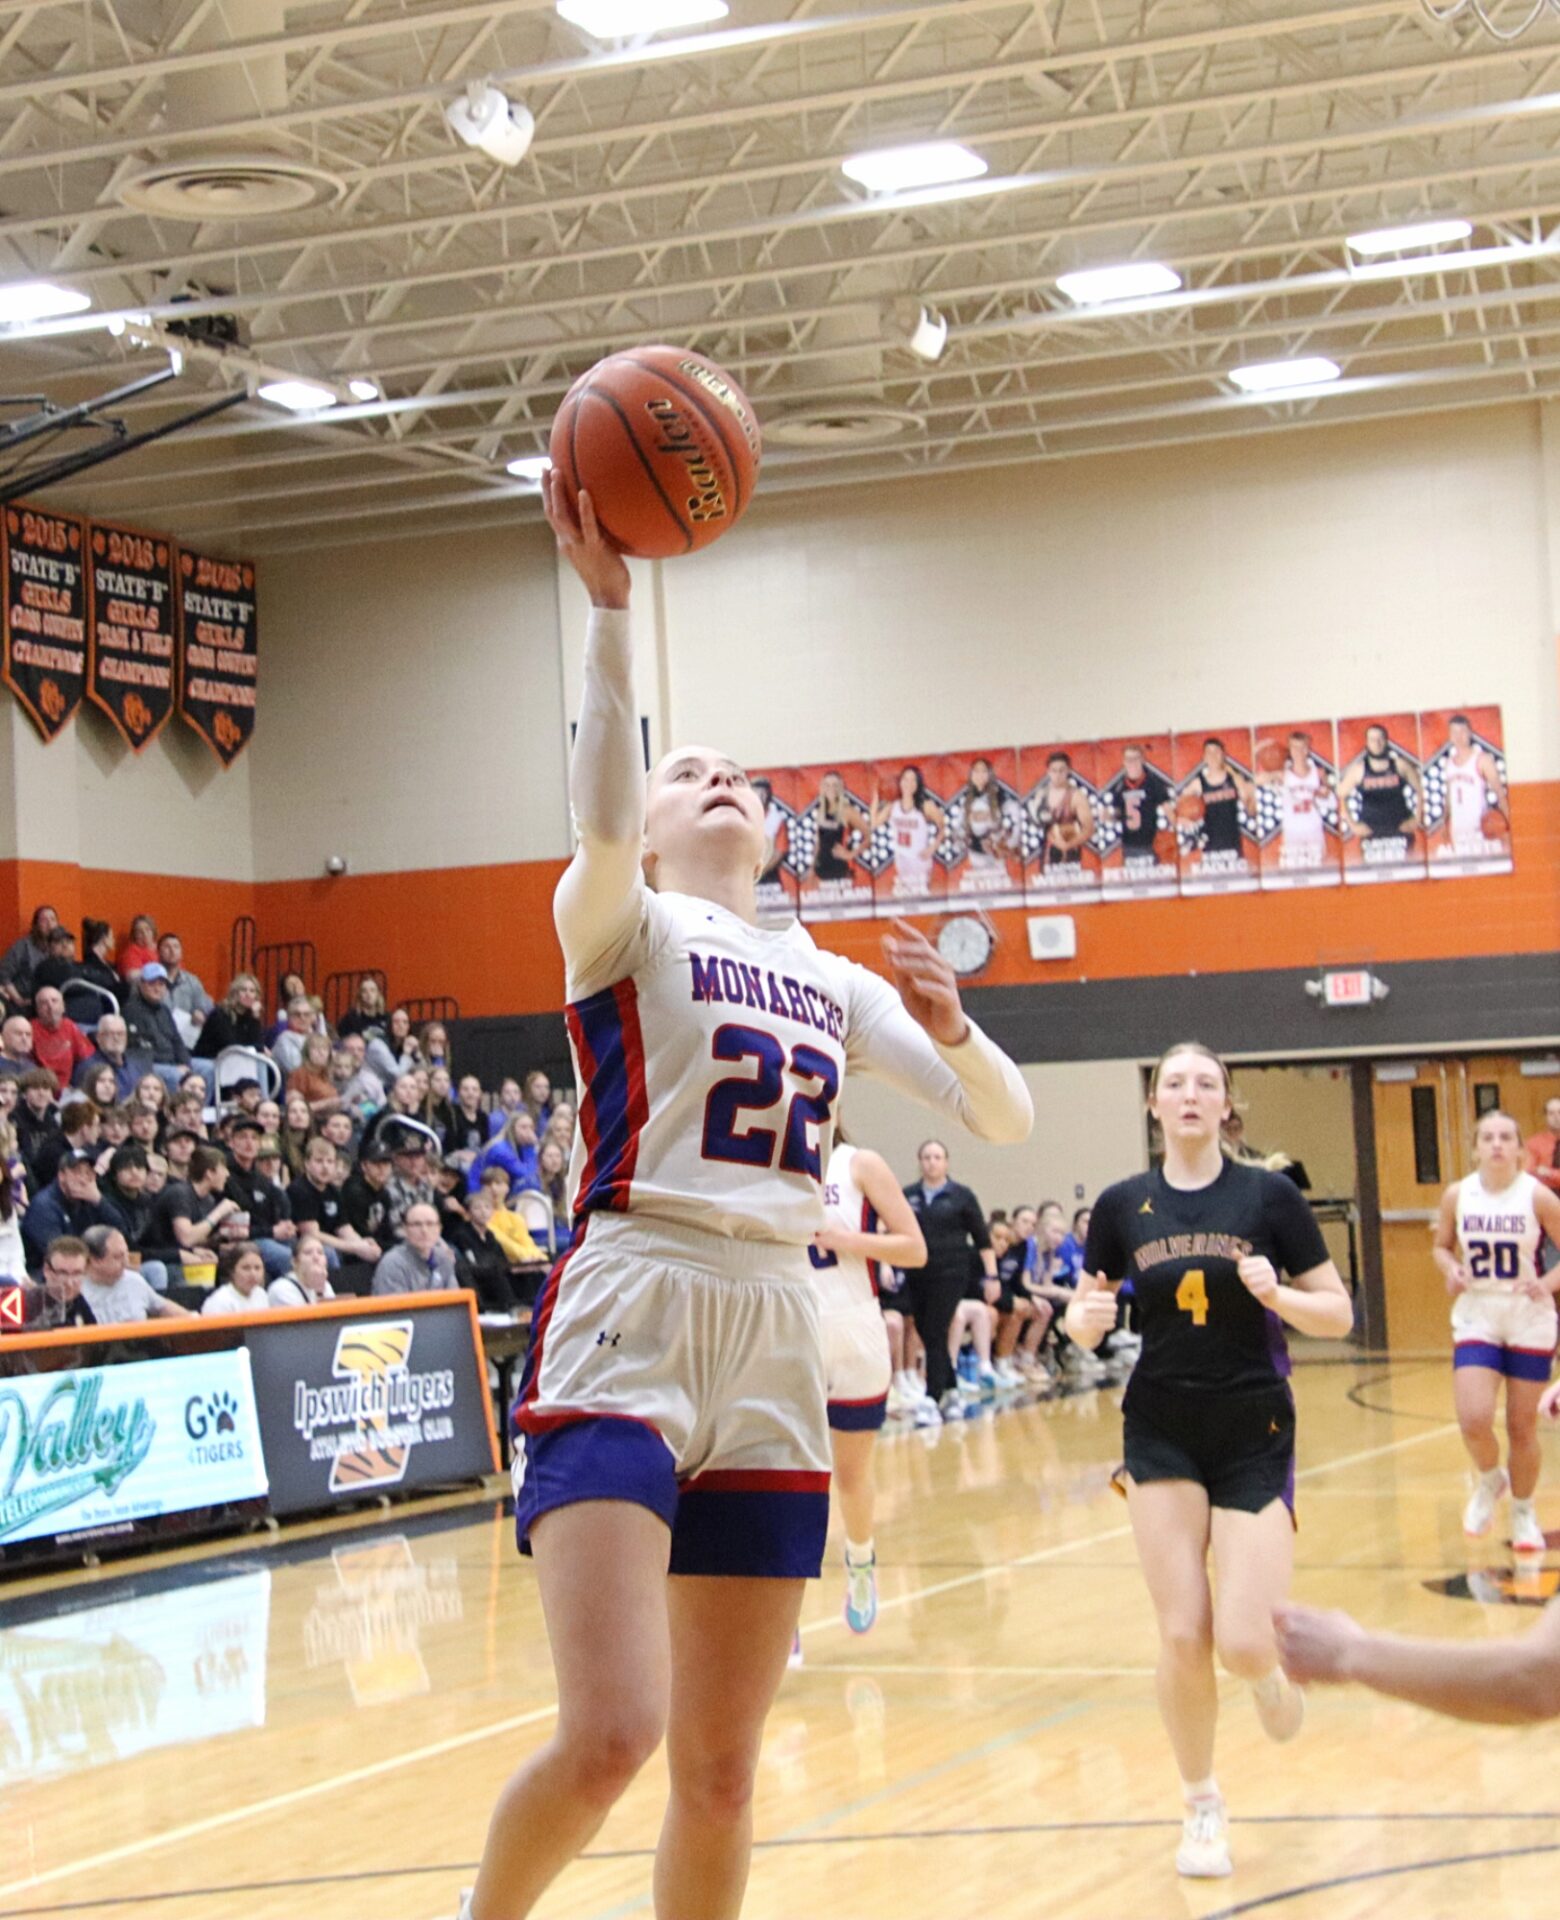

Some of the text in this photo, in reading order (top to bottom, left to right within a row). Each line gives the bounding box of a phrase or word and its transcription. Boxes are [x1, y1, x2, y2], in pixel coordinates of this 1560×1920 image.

[644, 399, 726, 522] Baden
[22, 512, 67, 553] 2015
[21, 580, 72, 614] GIRLS
[107, 599, 159, 631] GIRLS
[196, 620, 245, 650] GIRLS
[689, 951, 847, 1049] MONARCHS
[701, 1023, 839, 1184] 22
[1463, 1213, 1526, 1234] MONARCHS
[1468, 1241, 1519, 1279] 20
[1176, 1269, 1209, 1326] 4
[294, 1366, 454, 1440] Ipswich Tigers
[0, 1373, 157, 1498] Valley
[423, 1416, 454, 1442] CLUB
[196, 1440, 244, 1465] TIGERS
